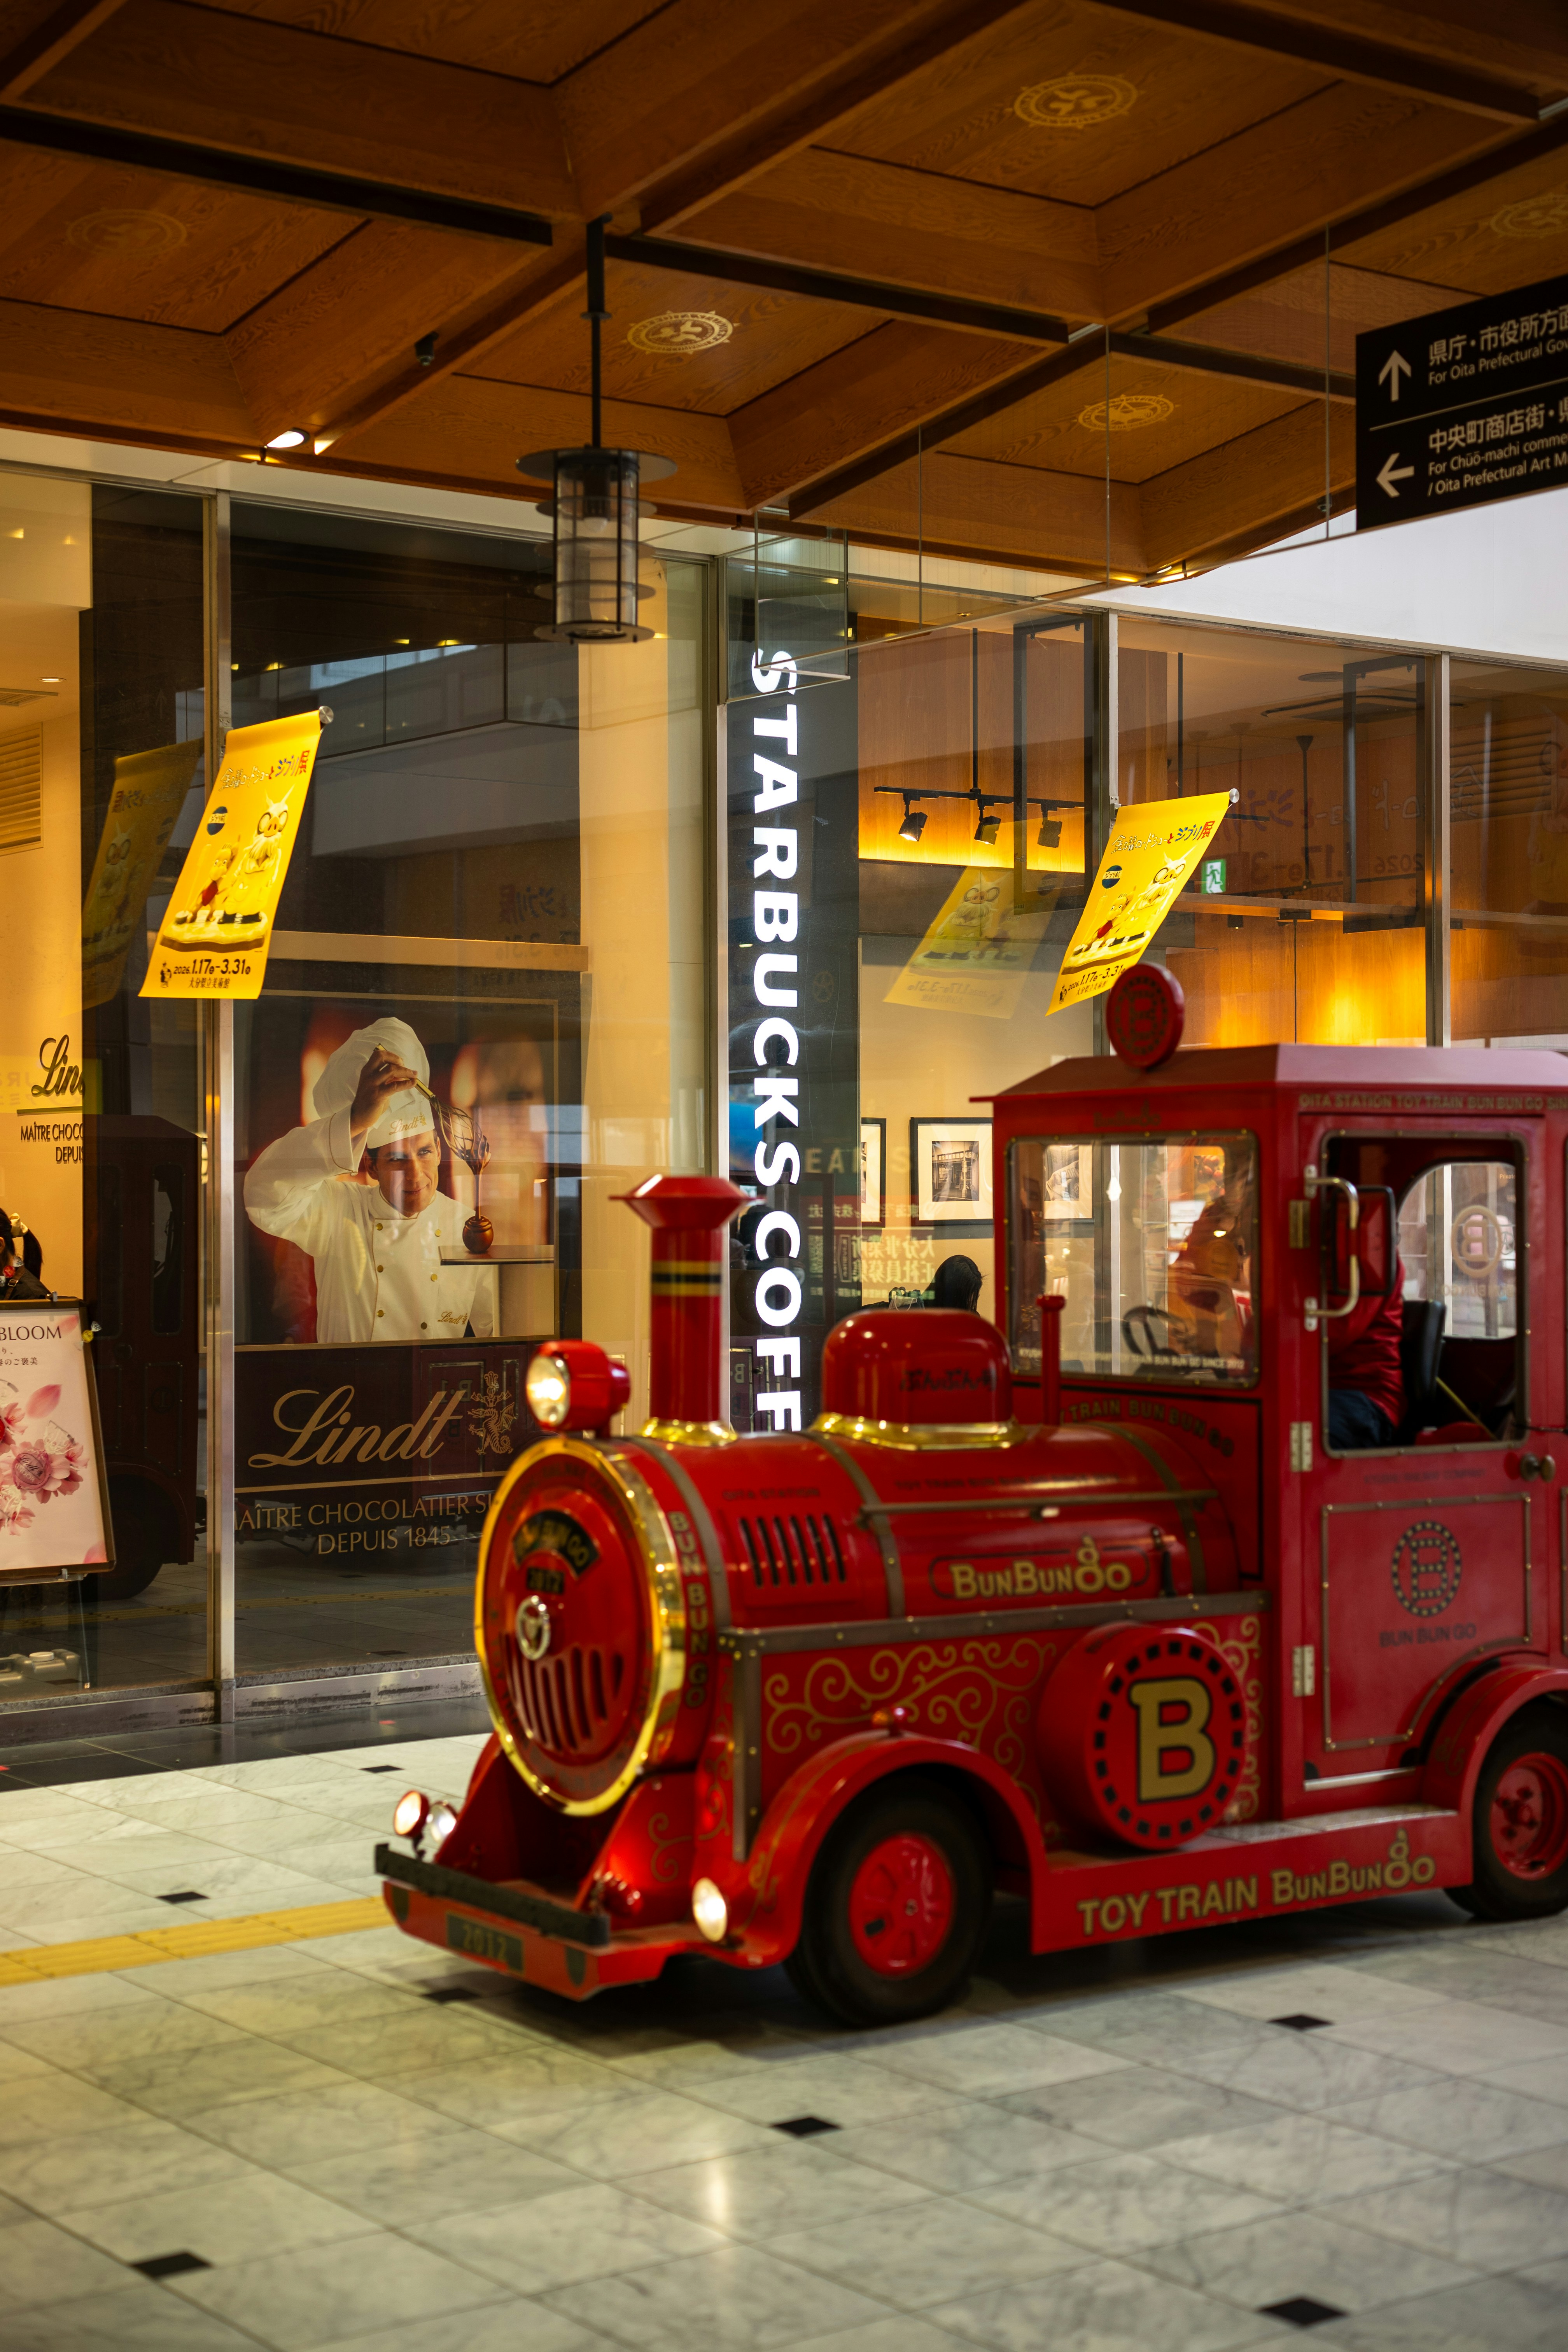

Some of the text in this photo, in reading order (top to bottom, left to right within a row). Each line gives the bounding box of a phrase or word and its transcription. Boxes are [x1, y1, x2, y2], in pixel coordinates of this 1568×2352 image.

[1429, 371, 1446, 386] For
[1450, 363, 1475, 380] Oita
[1479, 341, 1542, 370] Prefectural
[1428, 462, 1447, 476] For
[1463, 459, 1528, 488] Prefectural
[1530, 455, 1550, 472] Art
[751, 650, 800, 1187] STARBUCKS
[1299, 1092, 1331, 1108] OITA
[1335, 1093, 1392, 1109] STATION
[1396, 1094, 1421, 1109] TOY
[1425, 1095, 1463, 1110] TRAIN
[1468, 1096, 1494, 1110] BUN
[1496, 1096, 1522, 1110] BUN
[1525, 1097, 1544, 1110] GO
[21, 1122, 51, 1141] MAÎTRE
[438, 1311, 464, 1326] Lindt
[248, 1385, 467, 1468] Lindt
[1069, 1399, 1121, 1423] TRAIN
[1129, 1400, 1164, 1423] BUN
[1168, 1407, 1207, 1440] BUN
[234, 1503, 302, 1531] AÎTRE
[308, 1494, 470, 1526] CHOCOLATIER
[318, 1525, 451, 1555] DEPUIS 1845
[668, 1510, 709, 1708] BUN BUN GO
[1379, 1622, 1477, 1648] BUN BUN GO
[1129, 1676, 1216, 1804] B
[1077, 1889, 1152, 1936] TOY
[1156, 1874, 1258, 1923] TRAIN
